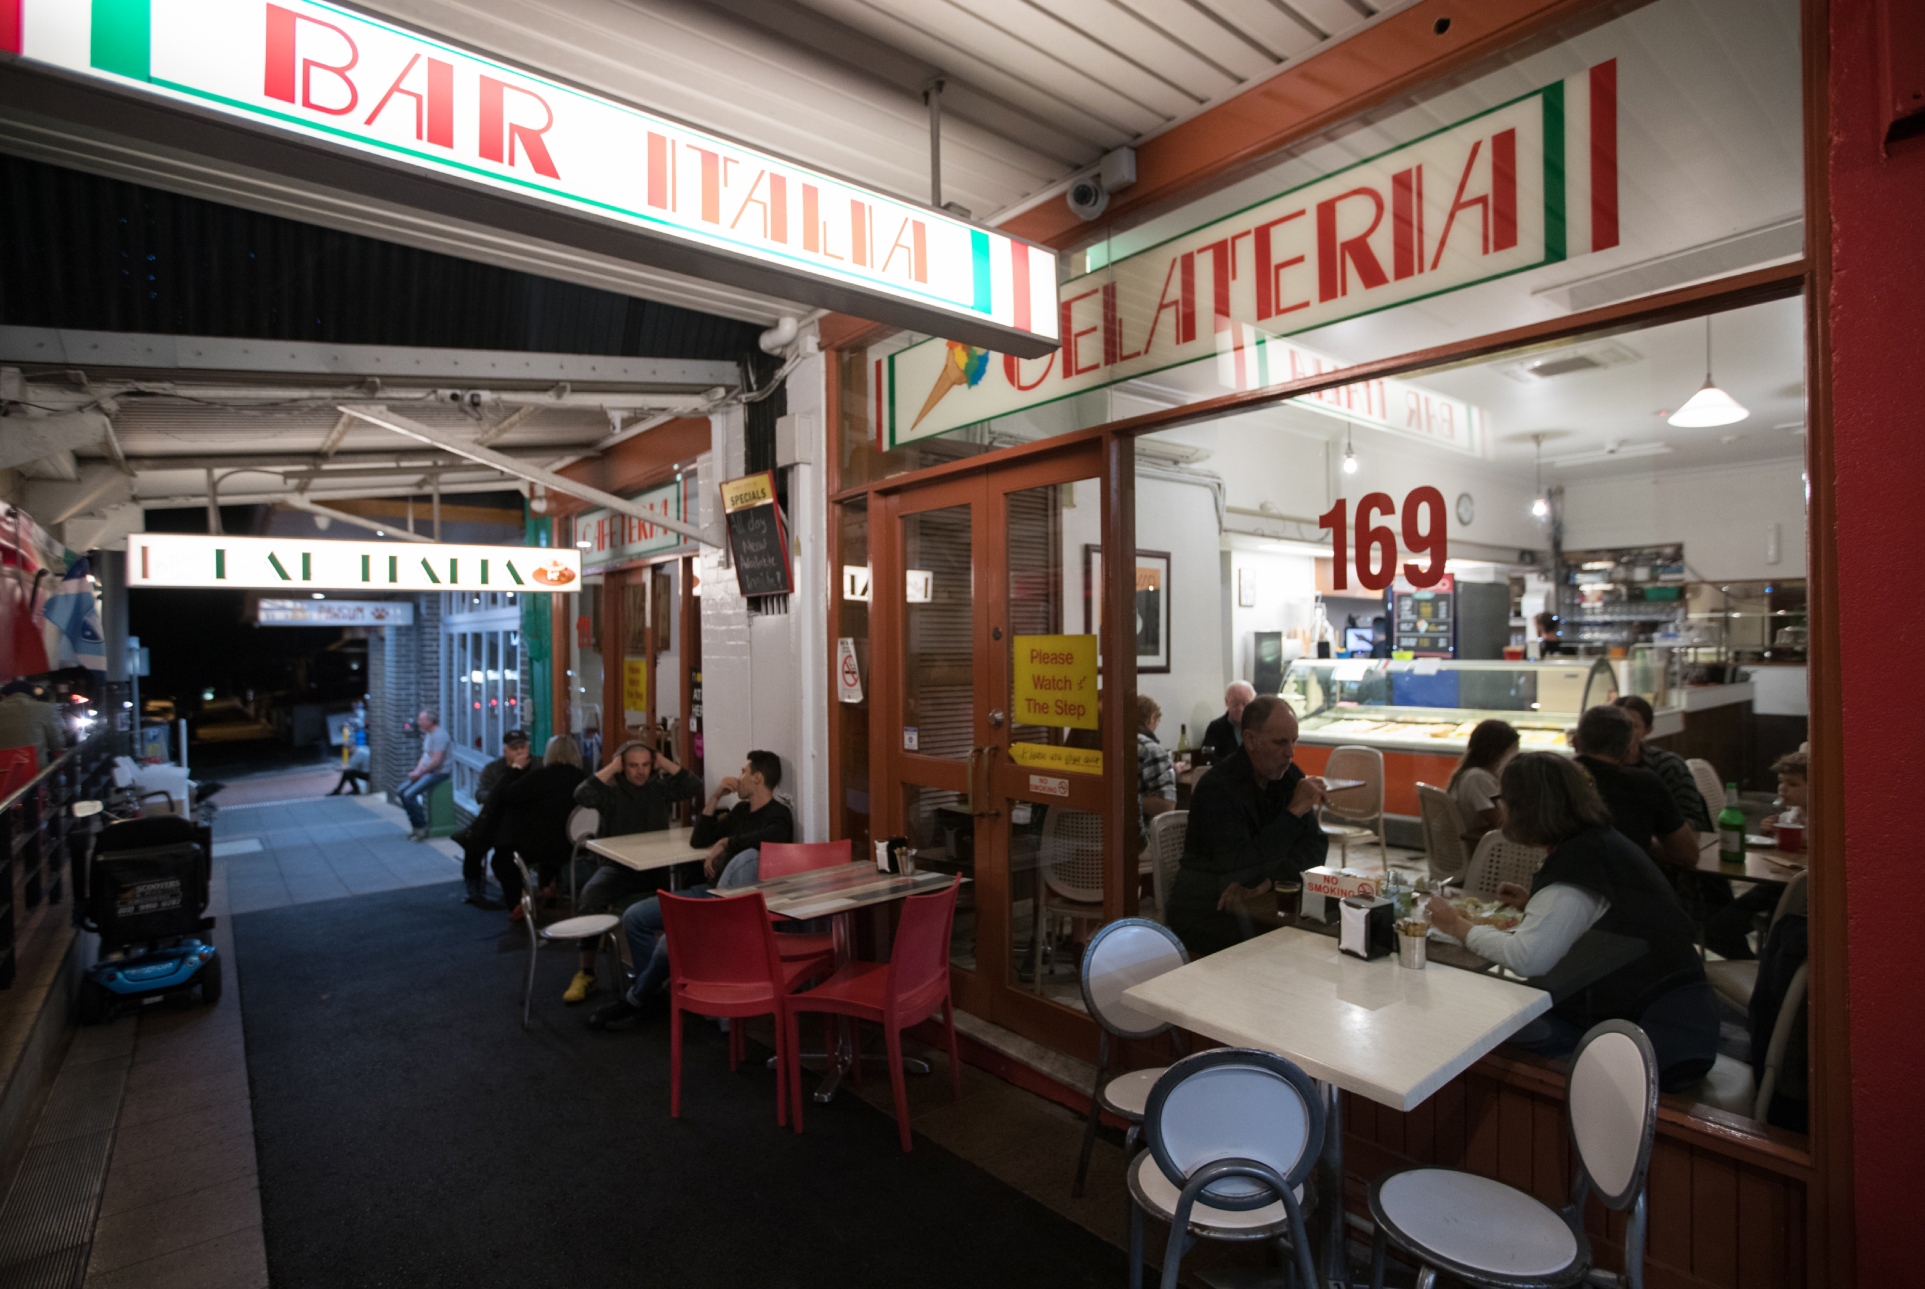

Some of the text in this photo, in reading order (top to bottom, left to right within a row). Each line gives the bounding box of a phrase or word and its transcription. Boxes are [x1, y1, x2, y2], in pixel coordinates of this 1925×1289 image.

[264, 2, 928, 284] BAR ITALIA
[730, 487, 767, 506] SPECIALS
[748, 511, 768, 534] day
[1319, 485, 1448, 591] 169
[1030, 648, 1074, 665] Please
[1032, 674, 1073, 691] Watch
[1025, 698, 1086, 720] The Step
[1029, 783, 1058, 794] SMOKING
[1038, 777, 1049, 785] NO
[136, 879, 182, 892] SCOOTERS
[1322, 874, 1339, 886] NO
[1307, 882, 1356, 898] SMOKING
